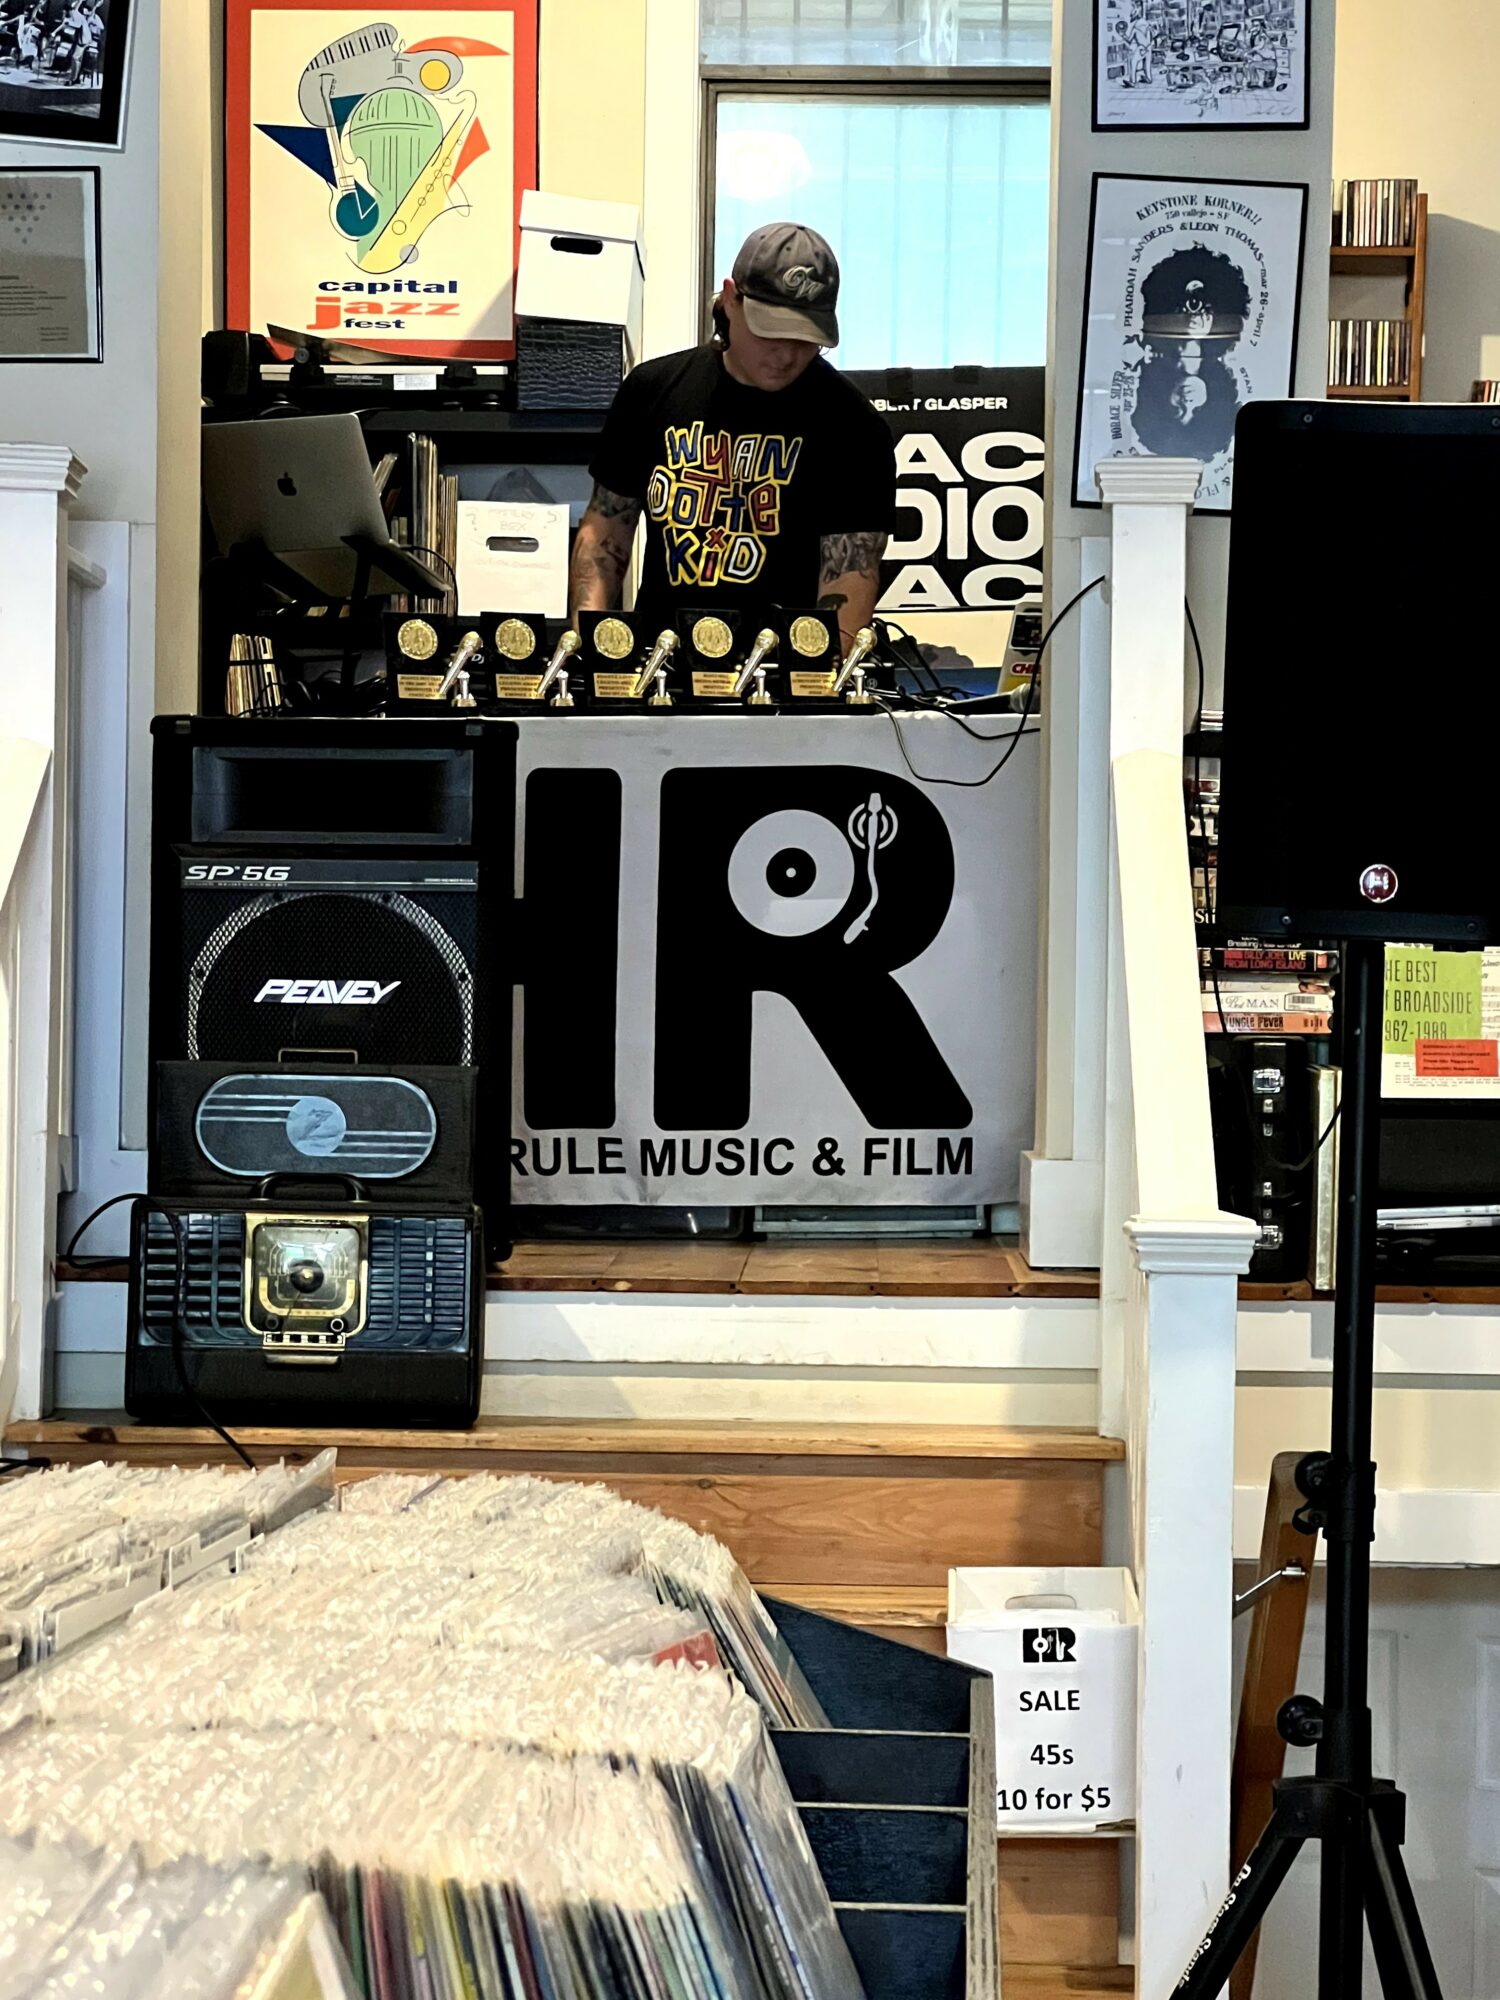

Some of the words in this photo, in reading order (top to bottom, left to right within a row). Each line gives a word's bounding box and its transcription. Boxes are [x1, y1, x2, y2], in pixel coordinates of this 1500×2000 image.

[1136, 194, 1198, 221] KEYSTONE
[318, 279, 458, 295] capital
[1123, 267, 1138, 328] PHAROAH
[1132, 223, 1174, 264] SANDERS
[306, 296, 460, 330] jazz
[343, 318, 406, 329] fest
[1110, 370, 1125, 400] SILVER
[1239, 366, 1254, 395] STAN
[924, 397, 1009, 411] GLASPER
[1109, 404, 1123, 440] HORACE
[894, 431, 1045, 483] AC
[882, 485, 1045, 560] DIO
[874, 564, 1044, 608] AC
[242, 866, 292, 881] 5G
[1223, 960, 1248, 969] FROM
[1250, 960, 1273, 970] LONG
[1275, 960, 1306, 970] ISLAND
[1244, 950, 1265, 960] BILLY
[1266, 950, 1285, 960] JOEL
[1288, 950, 1307, 961] LIVE
[1406, 960, 1437, 982] BEST
[253, 979, 401, 1004] PEAVEY
[1247, 999, 1280, 1009] MAN
[1394, 989, 1473, 1015] BROADSIDE
[509, 1137, 627, 1177] RULE
[640, 1137, 795, 1178] MUSIC
[811, 1137, 846, 1177] &
[863, 1137, 974, 1177] FILM
[1019, 1690, 1080, 1712] SALE
[1030, 1744, 1074, 1765] 45s
[997, 1789, 1027, 1811] 10
[1035, 1787, 1073, 1810] for
[1080, 1784, 1111, 1812] $5
